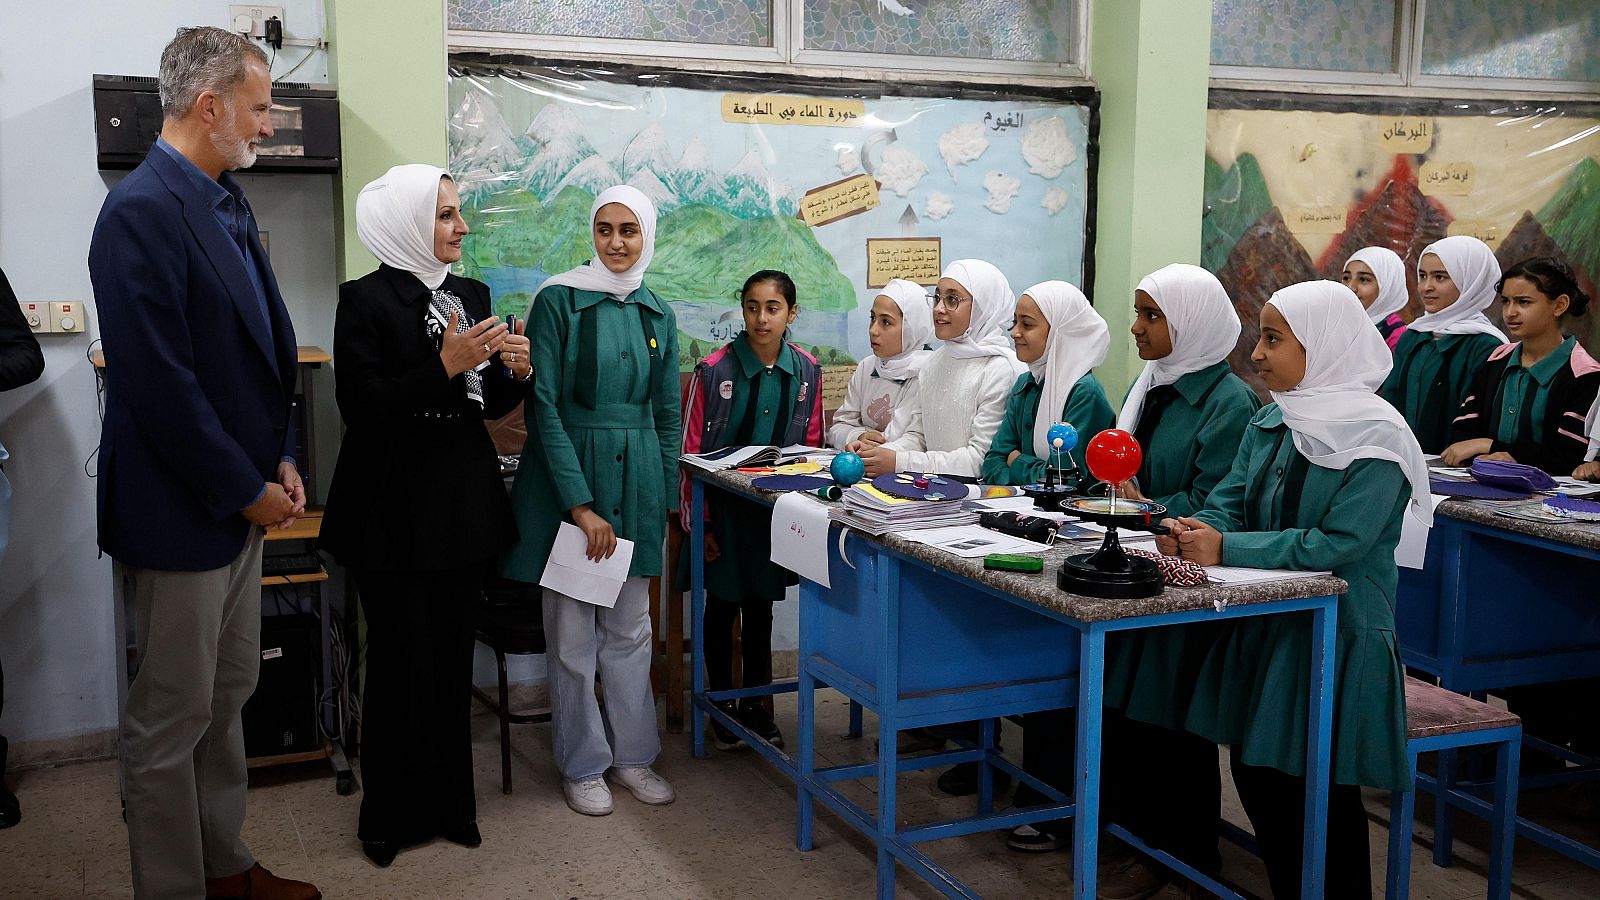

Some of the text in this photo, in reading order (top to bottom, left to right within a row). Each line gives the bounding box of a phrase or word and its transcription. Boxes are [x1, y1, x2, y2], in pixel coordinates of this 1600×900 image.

[733, 102, 857, 122] دورة الماء في الطبيعة
[983, 111, 1024, 131] الغيوم
[1383, 121, 1427, 141] البركان
[1426, 171, 1450, 183] البركان
